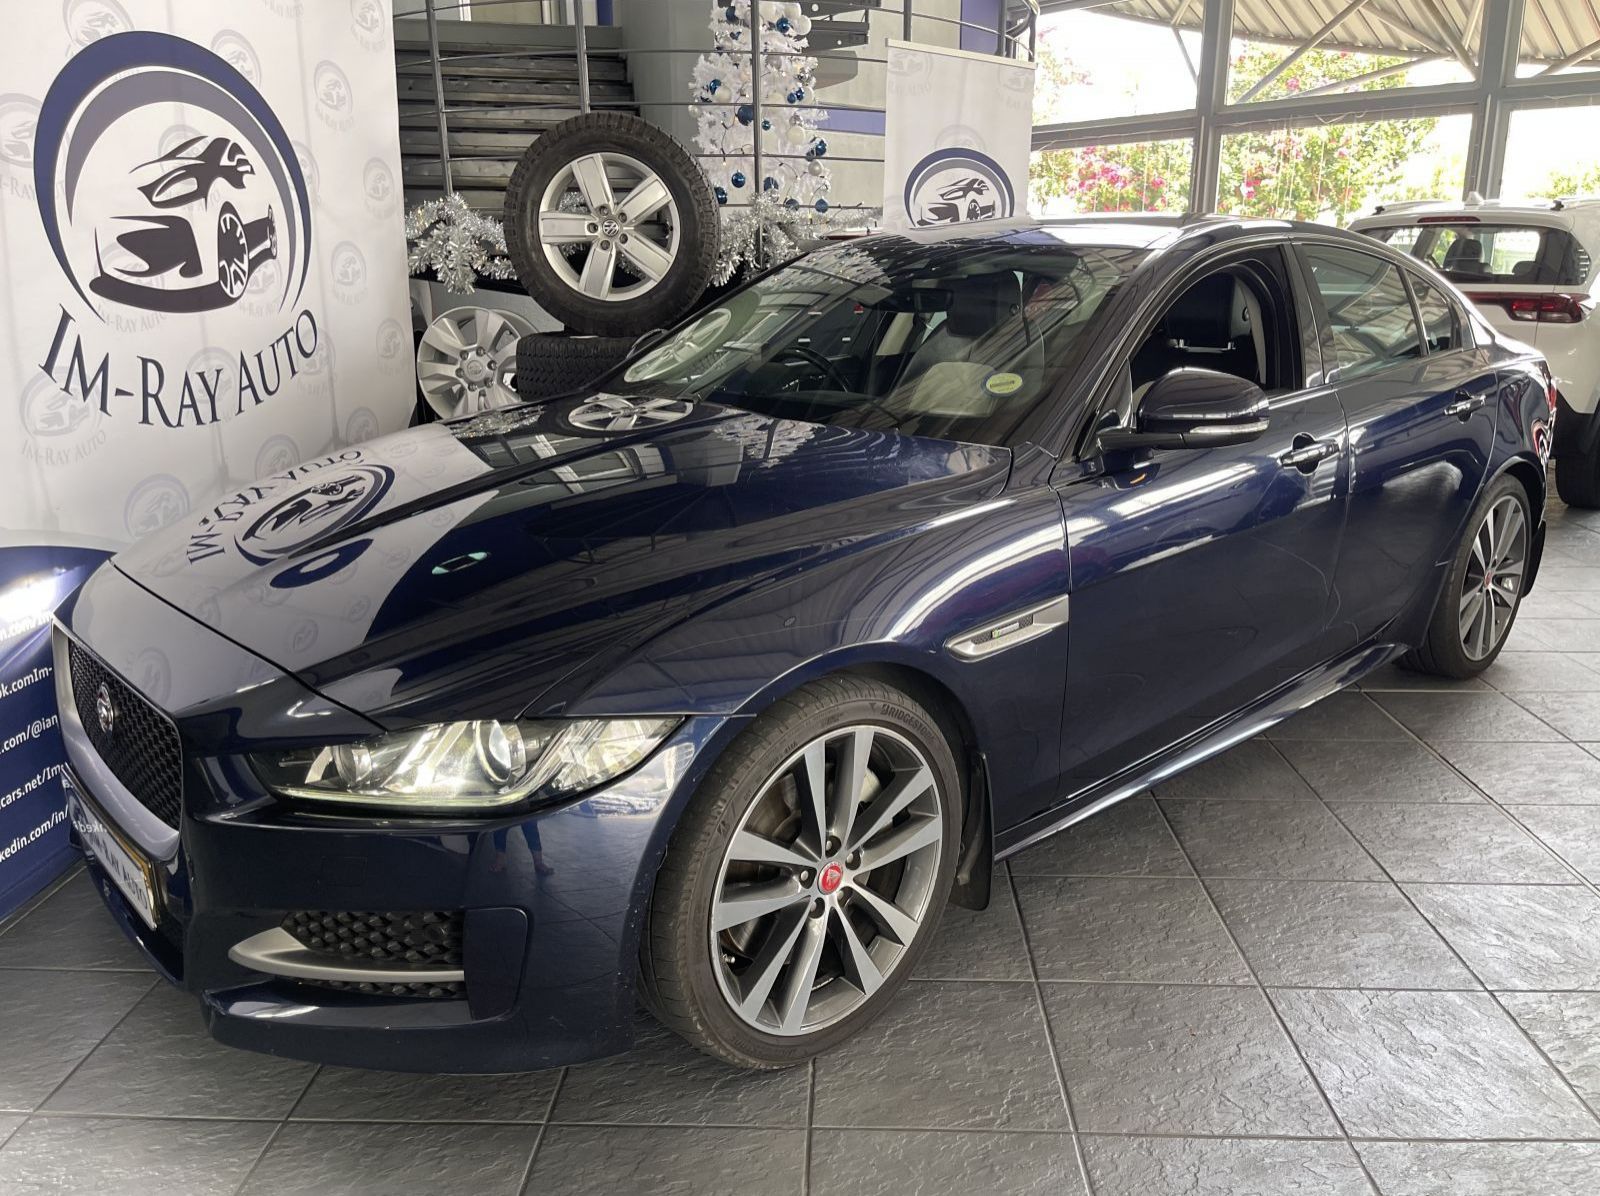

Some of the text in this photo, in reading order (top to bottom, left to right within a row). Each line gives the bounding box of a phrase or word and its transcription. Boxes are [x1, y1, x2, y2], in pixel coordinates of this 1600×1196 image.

[38, 304, 318, 429] IM-RAY AUTO
[0, 667, 53, 699] k.comIm-
[0, 714, 58, 755] .com/@ian
